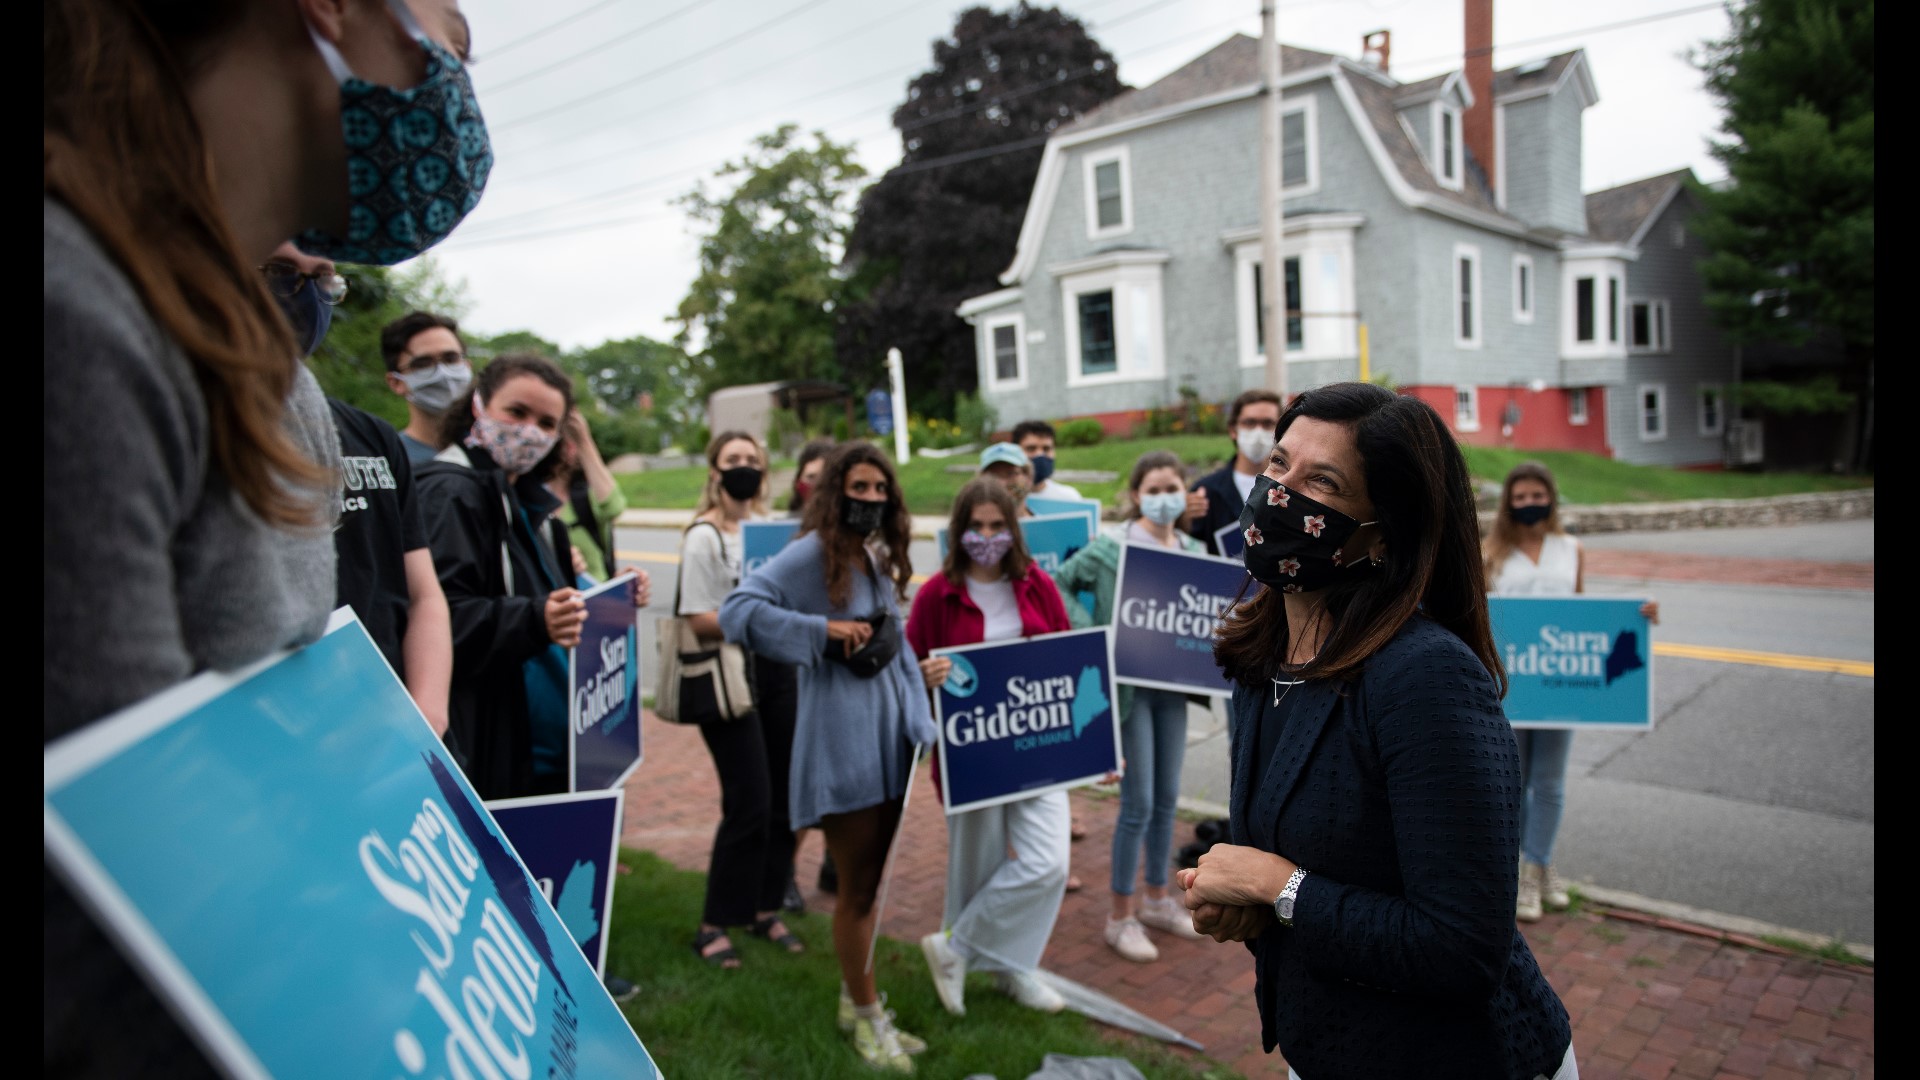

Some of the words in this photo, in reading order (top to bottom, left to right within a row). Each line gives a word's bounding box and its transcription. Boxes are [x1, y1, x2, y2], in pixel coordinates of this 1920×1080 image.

[601, 635, 627, 675] Sara
[1539, 624, 1610, 653] Sara
[575, 669, 626, 735] Gideon
[1006, 675, 1075, 708] Sara
[946, 702, 1071, 746] Gideon
[358, 798, 479, 978] Sara
